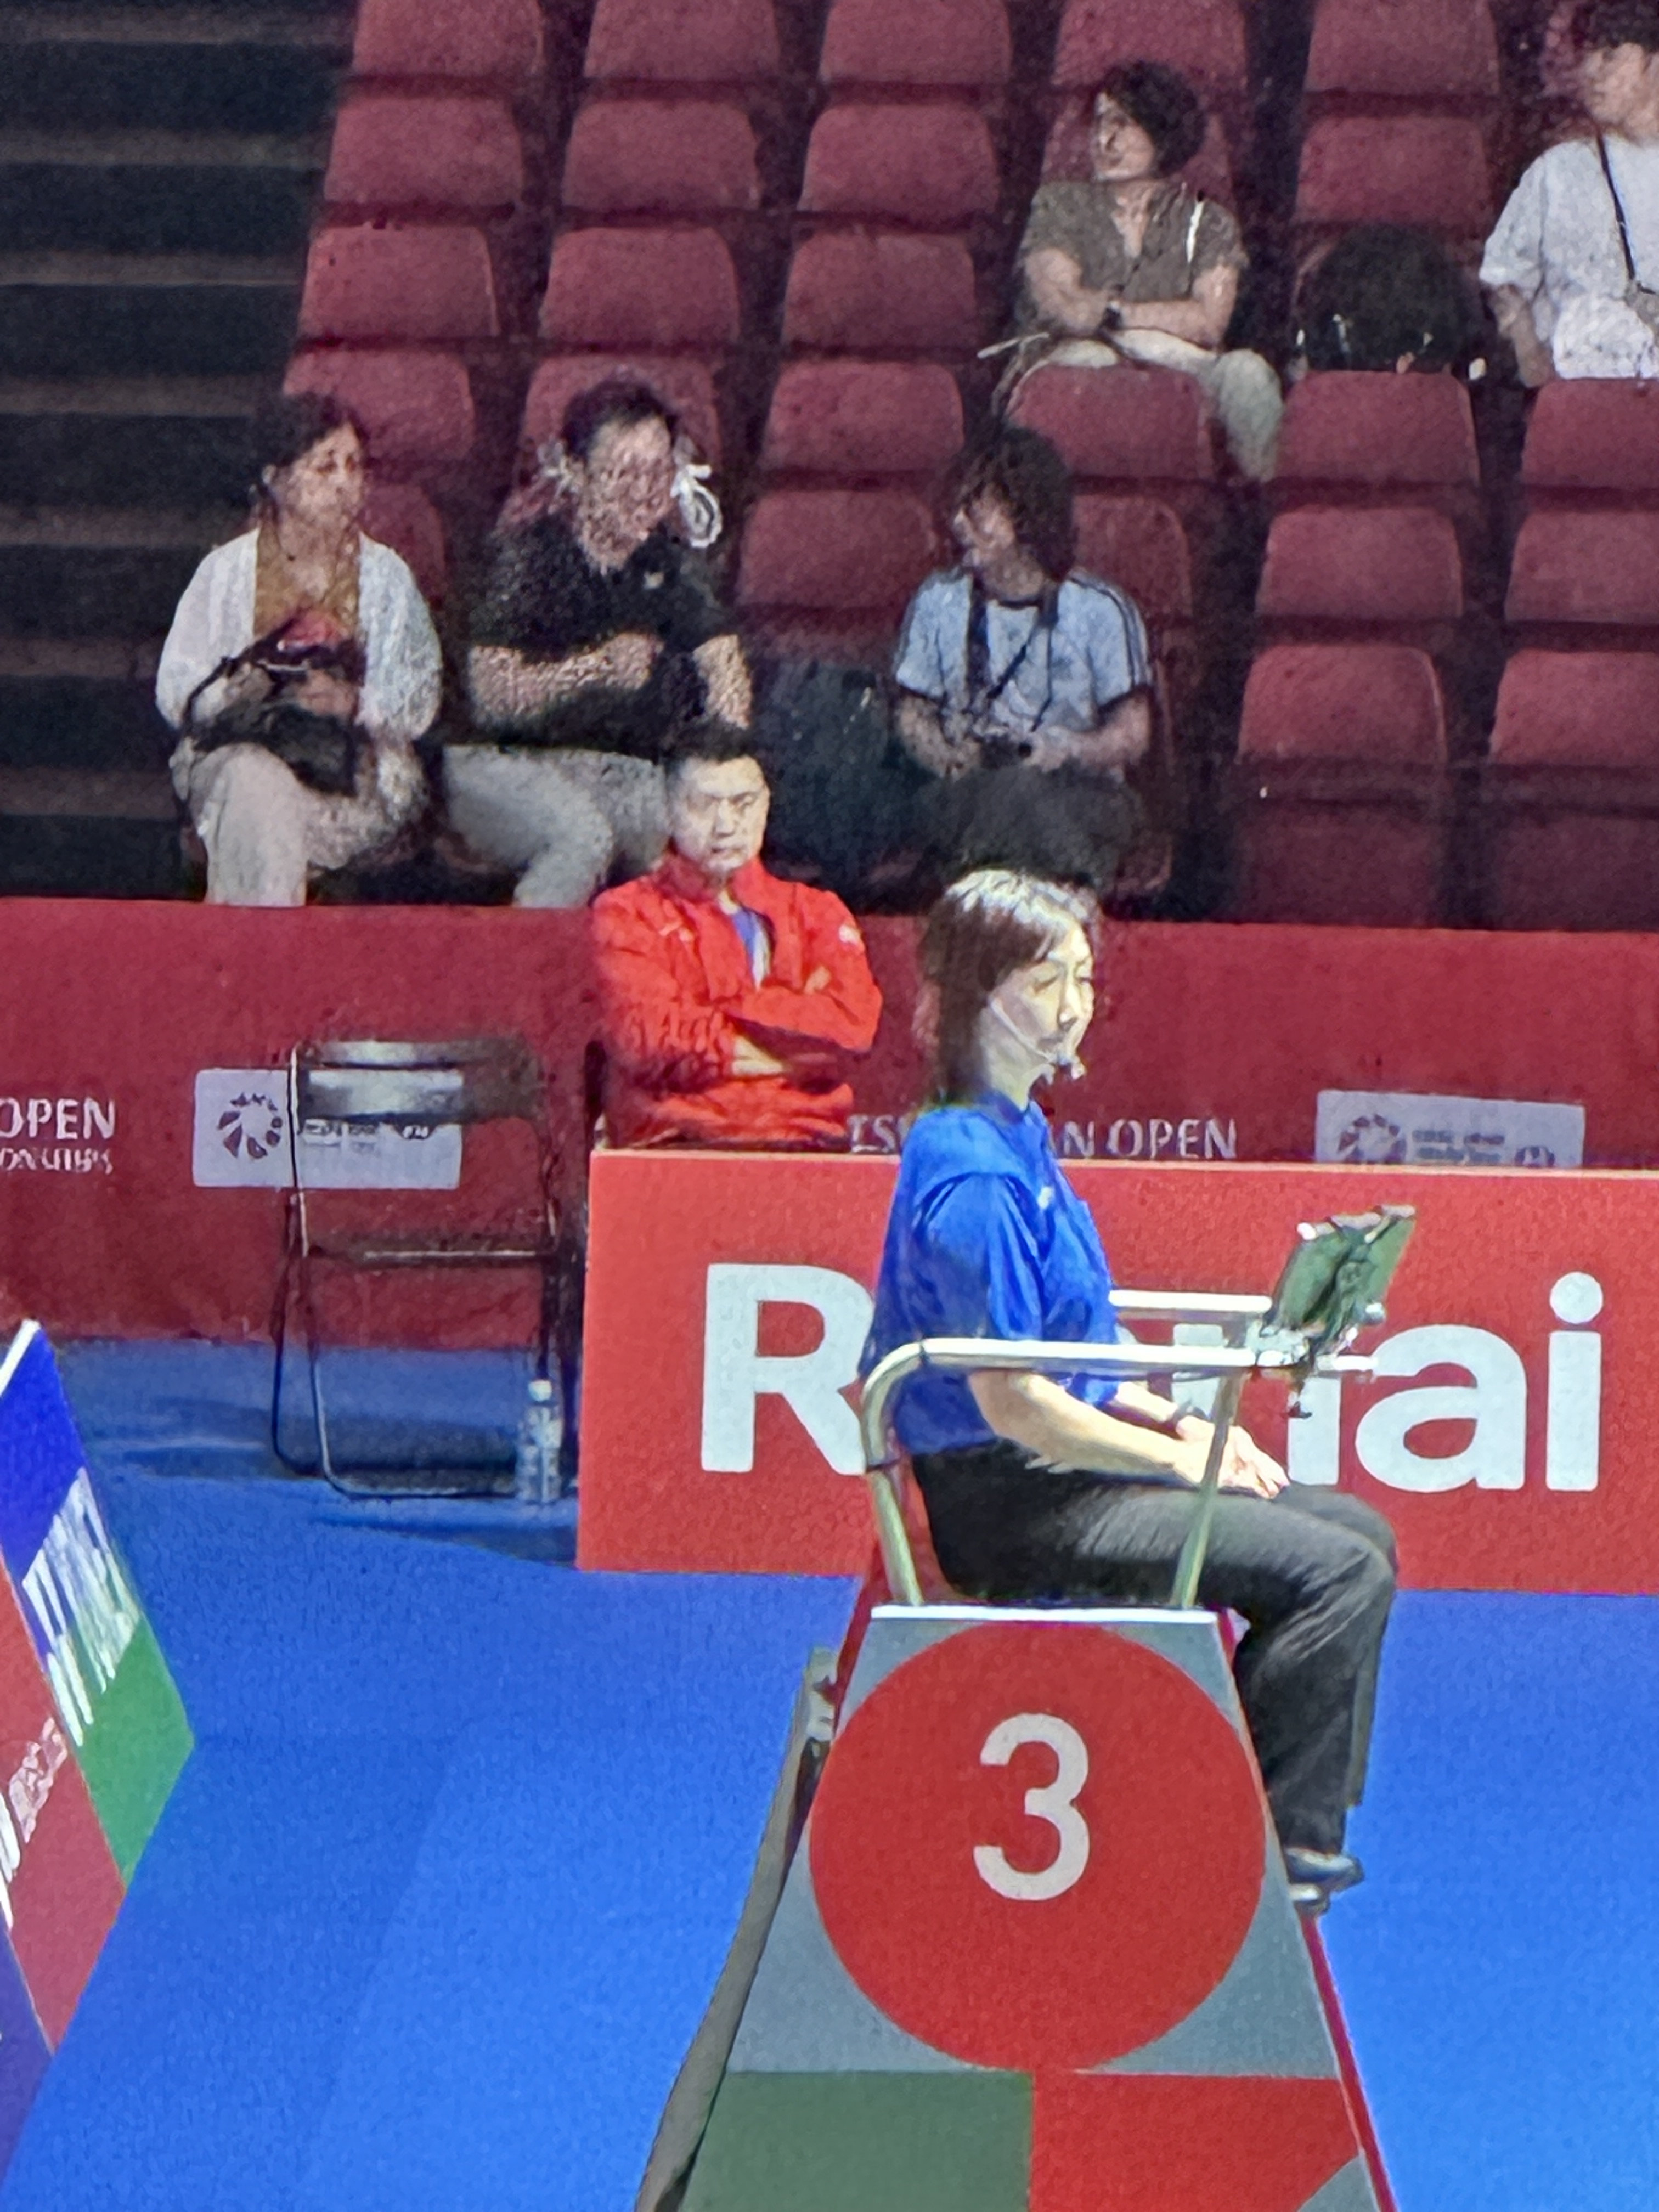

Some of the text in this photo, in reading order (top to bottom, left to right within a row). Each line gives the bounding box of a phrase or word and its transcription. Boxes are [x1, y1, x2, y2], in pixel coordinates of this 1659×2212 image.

[0, 1097, 115, 1140] OPEN
[1107, 1118, 1238, 1159] OPEN
[701, 1263, 1604, 1493] Rnai
[973, 1712, 1090, 1901] 3
